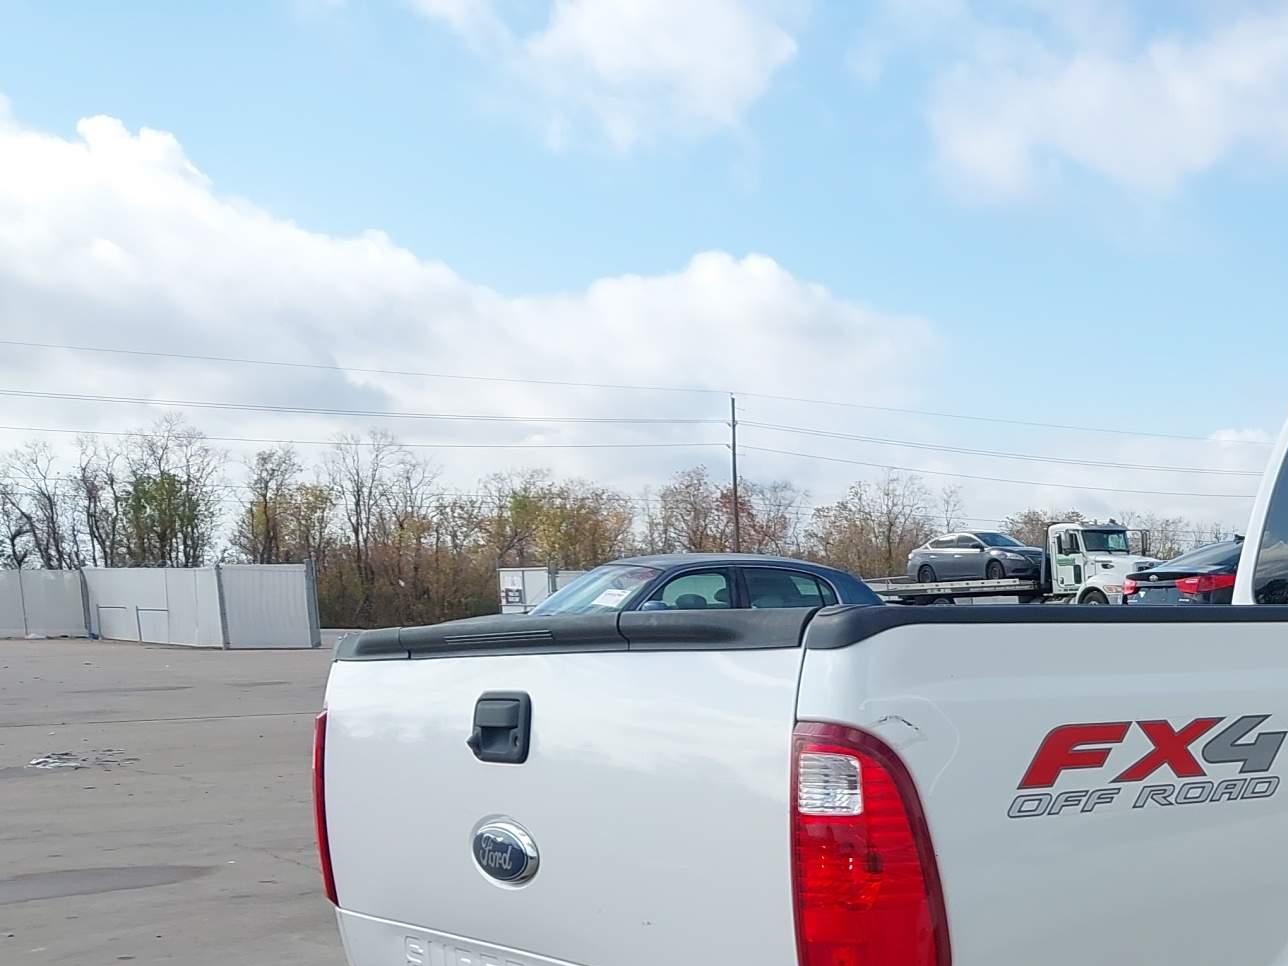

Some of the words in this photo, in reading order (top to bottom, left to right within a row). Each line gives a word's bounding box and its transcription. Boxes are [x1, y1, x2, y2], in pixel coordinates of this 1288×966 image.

[1016, 713, 1288, 791] FX4
[1007, 786, 1122, 819] OFF
[1132, 775, 1281, 809] ROAD
[480, 833, 513, 870] Ford
